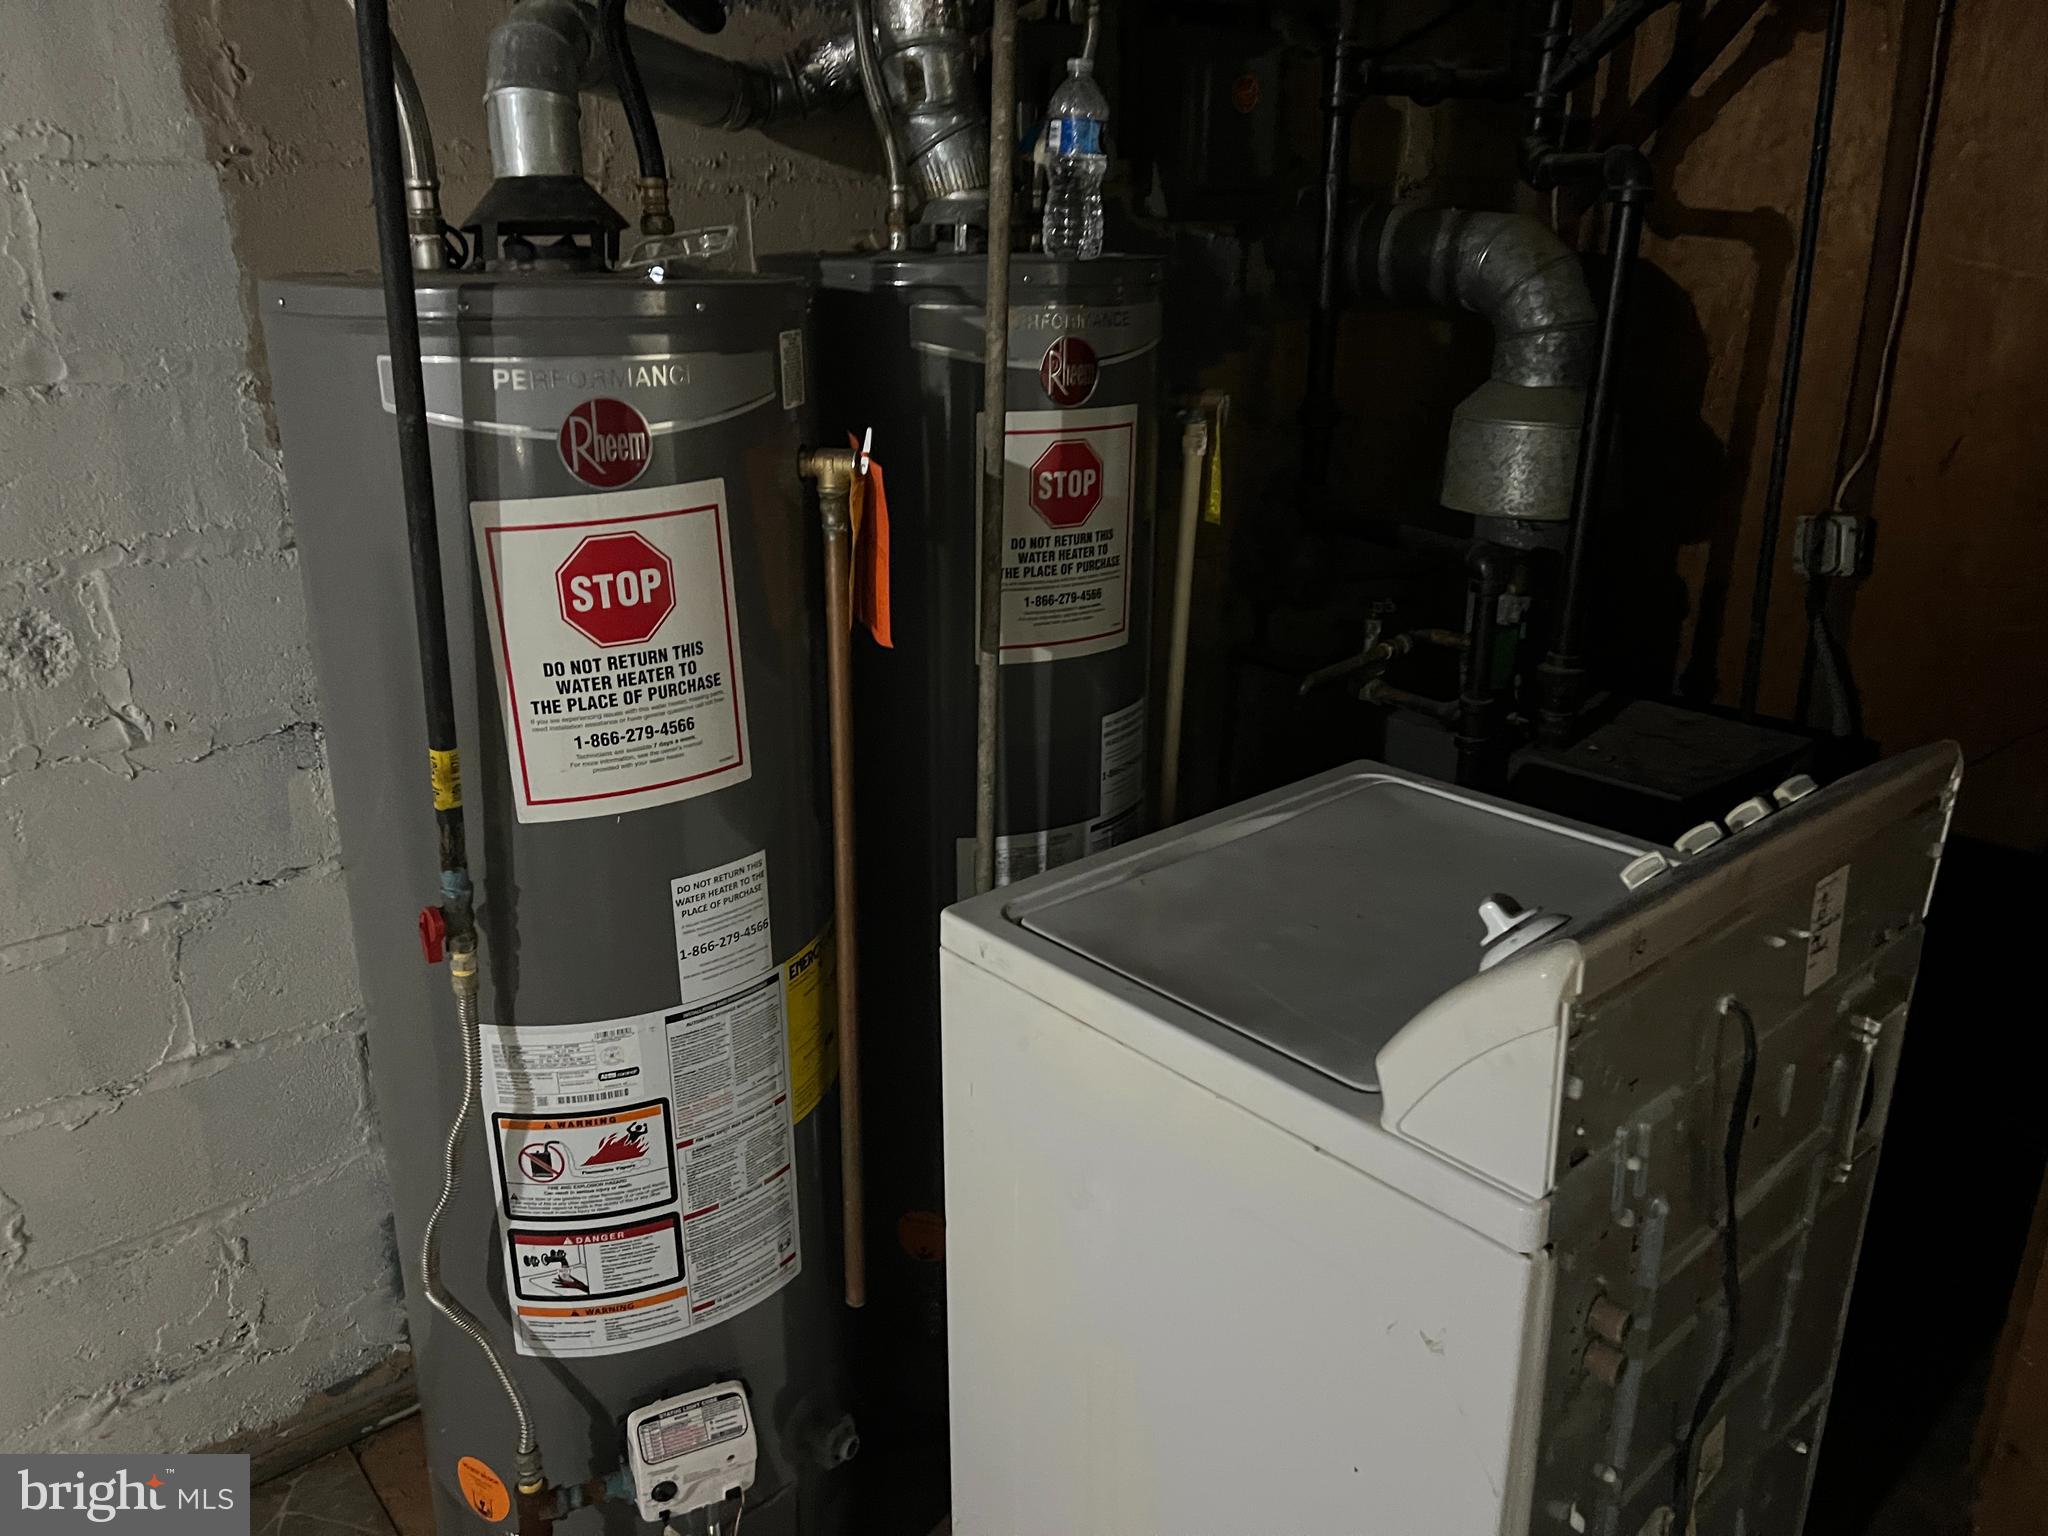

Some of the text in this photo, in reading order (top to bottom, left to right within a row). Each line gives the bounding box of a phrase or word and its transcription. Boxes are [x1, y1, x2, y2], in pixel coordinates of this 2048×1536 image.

[1048, 336, 1095, 397] Rheem
[569, 401, 647, 475] Rheem
[1038, 468, 1097, 500] STOP
[1011, 528, 1114, 550] DO NOT RETURN THIS
[1018, 543, 1109, 564] WATER HEATER TO
[1023, 564, 1057, 578] PLACE
[1061, 562, 1074, 575] OF
[1076, 555, 1121, 574] PURCHASE
[570, 567, 662, 613] STOP
[1024, 588, 1102, 608] 1-866-279-4566
[543, 641, 704, 677] DO NOT RETURN THIS
[530, 672, 722, 715] THE PLACE OF PURCHASE
[556, 660, 697, 695] WATER HEATER TO
[574, 717, 695, 749] 1-866-279-4566
[675, 869, 765, 907] WATER HEATER TO THE
[677, 859, 763, 895] DO NOT RETURN THIS
[681, 883, 762, 918] PLACE OF PURCHASE
[680, 918, 769, 960] 1-866-279-4566
[557, 1116, 617, 1129] WARNING
[575, 1231, 625, 1244] DANGER
[585, 1302, 635, 1316] WARNING
